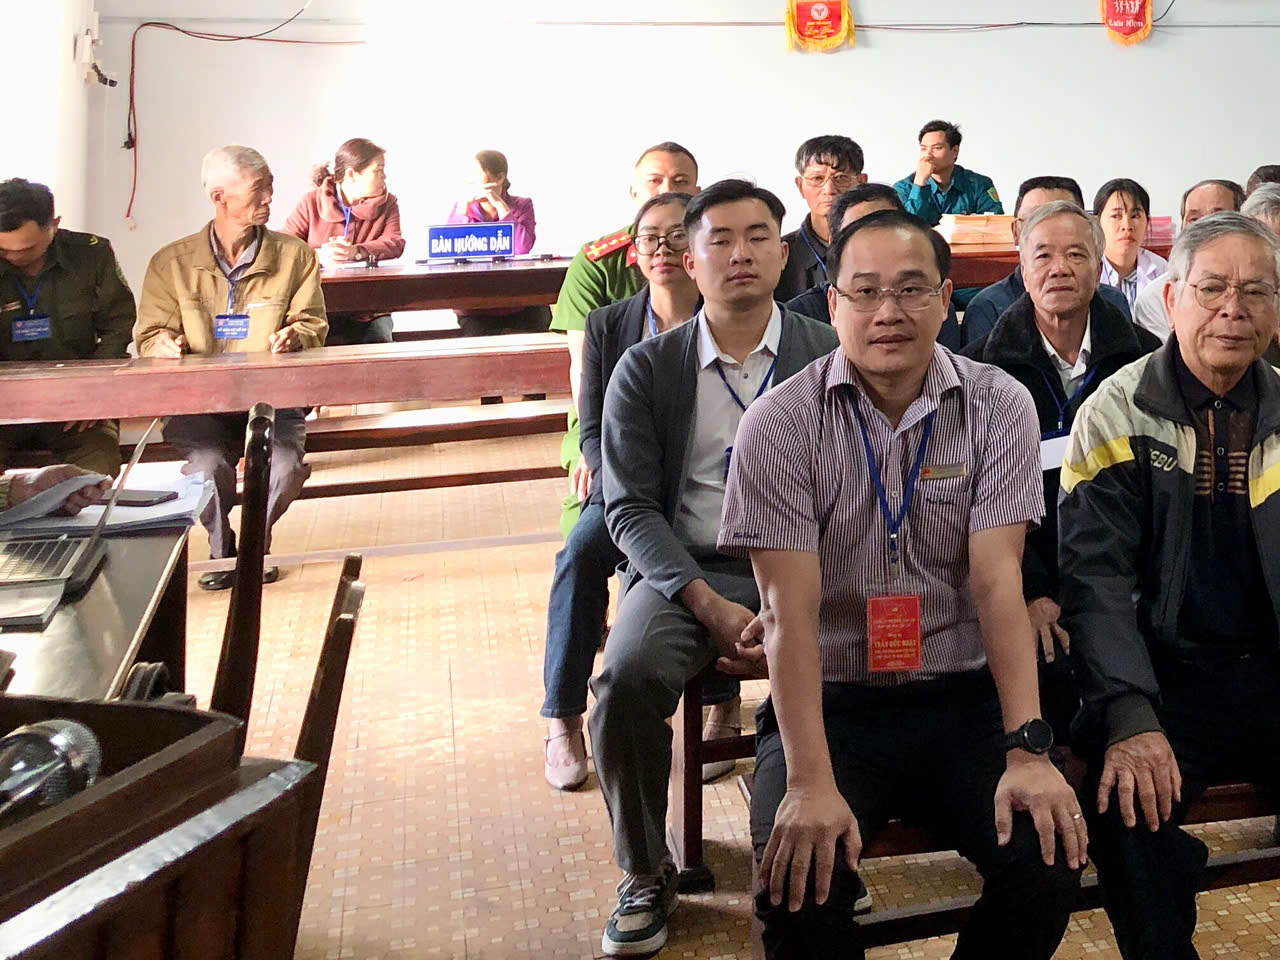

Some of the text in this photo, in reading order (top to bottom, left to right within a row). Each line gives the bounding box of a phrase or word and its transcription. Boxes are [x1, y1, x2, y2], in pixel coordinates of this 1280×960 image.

[431, 230, 510, 254] BÀN HƯỚNG DẪN
